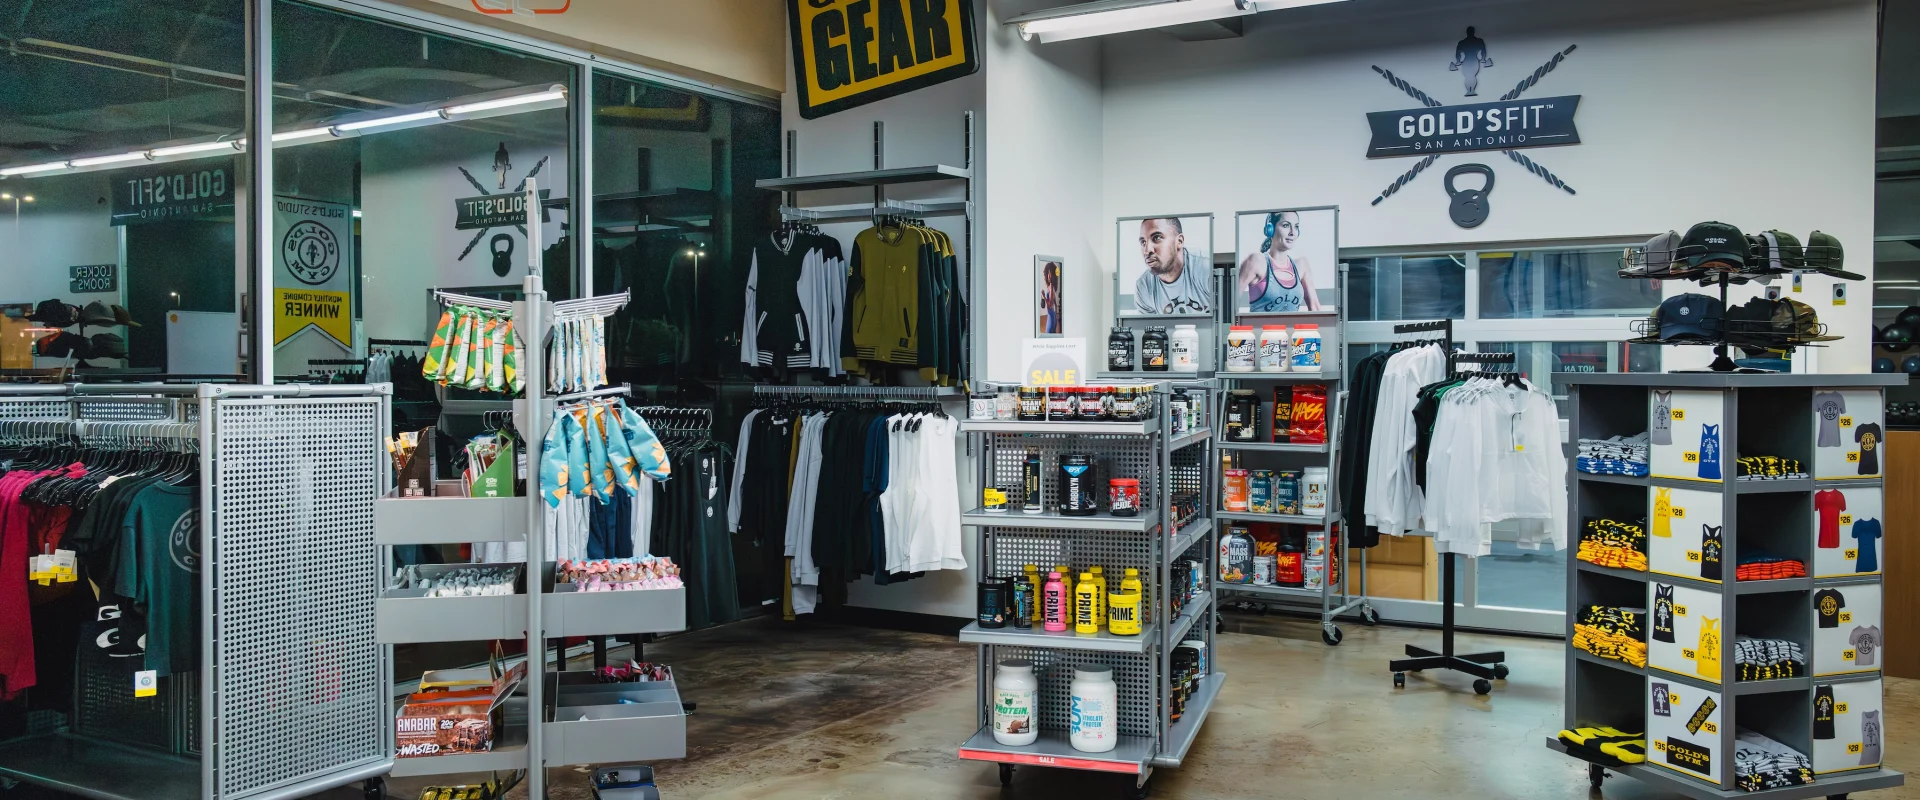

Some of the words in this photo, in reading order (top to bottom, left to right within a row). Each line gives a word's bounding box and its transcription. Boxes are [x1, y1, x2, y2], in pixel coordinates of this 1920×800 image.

[811, 0, 953, 91] GEAR
[1414, 140, 1443, 149] SAN
[1453, 134, 1526, 148] ANTONIO
[1031, 369, 1077, 385] SALE
[1291, 401, 1324, 421] MASS
[1672, 411, 1683, 419] $28
[1840, 418, 1851, 426] $26
[1684, 453, 1696, 461] $28
[1846, 453, 1857, 461] $26
[1069, 477, 1079, 510] KARBOLYN
[1112, 500, 1132, 510] HYDE
[1671, 508, 1683, 517] $28
[1229, 547, 1249, 556] MASS
[1845, 550, 1855, 558] $26
[1687, 552, 1699, 561] $28
[1046, 590, 1059, 624] PRIME
[1078, 592, 1092, 625] PRIME
[1674, 606, 1686, 615] $28
[1839, 613, 1850, 621] $26
[1683, 649, 1695, 658] $28
[1836, 704, 1847, 712] $28
[397, 717, 437, 731] ANABAR
[1705, 722, 1717, 733] $20
[401, 743, 440, 756] WASTED
[1655, 741, 1666, 751] $35
[1848, 744, 1859, 752] $28
[1667, 744, 1710, 762] GOLD'S
[1039, 756, 1055, 764] SALE
